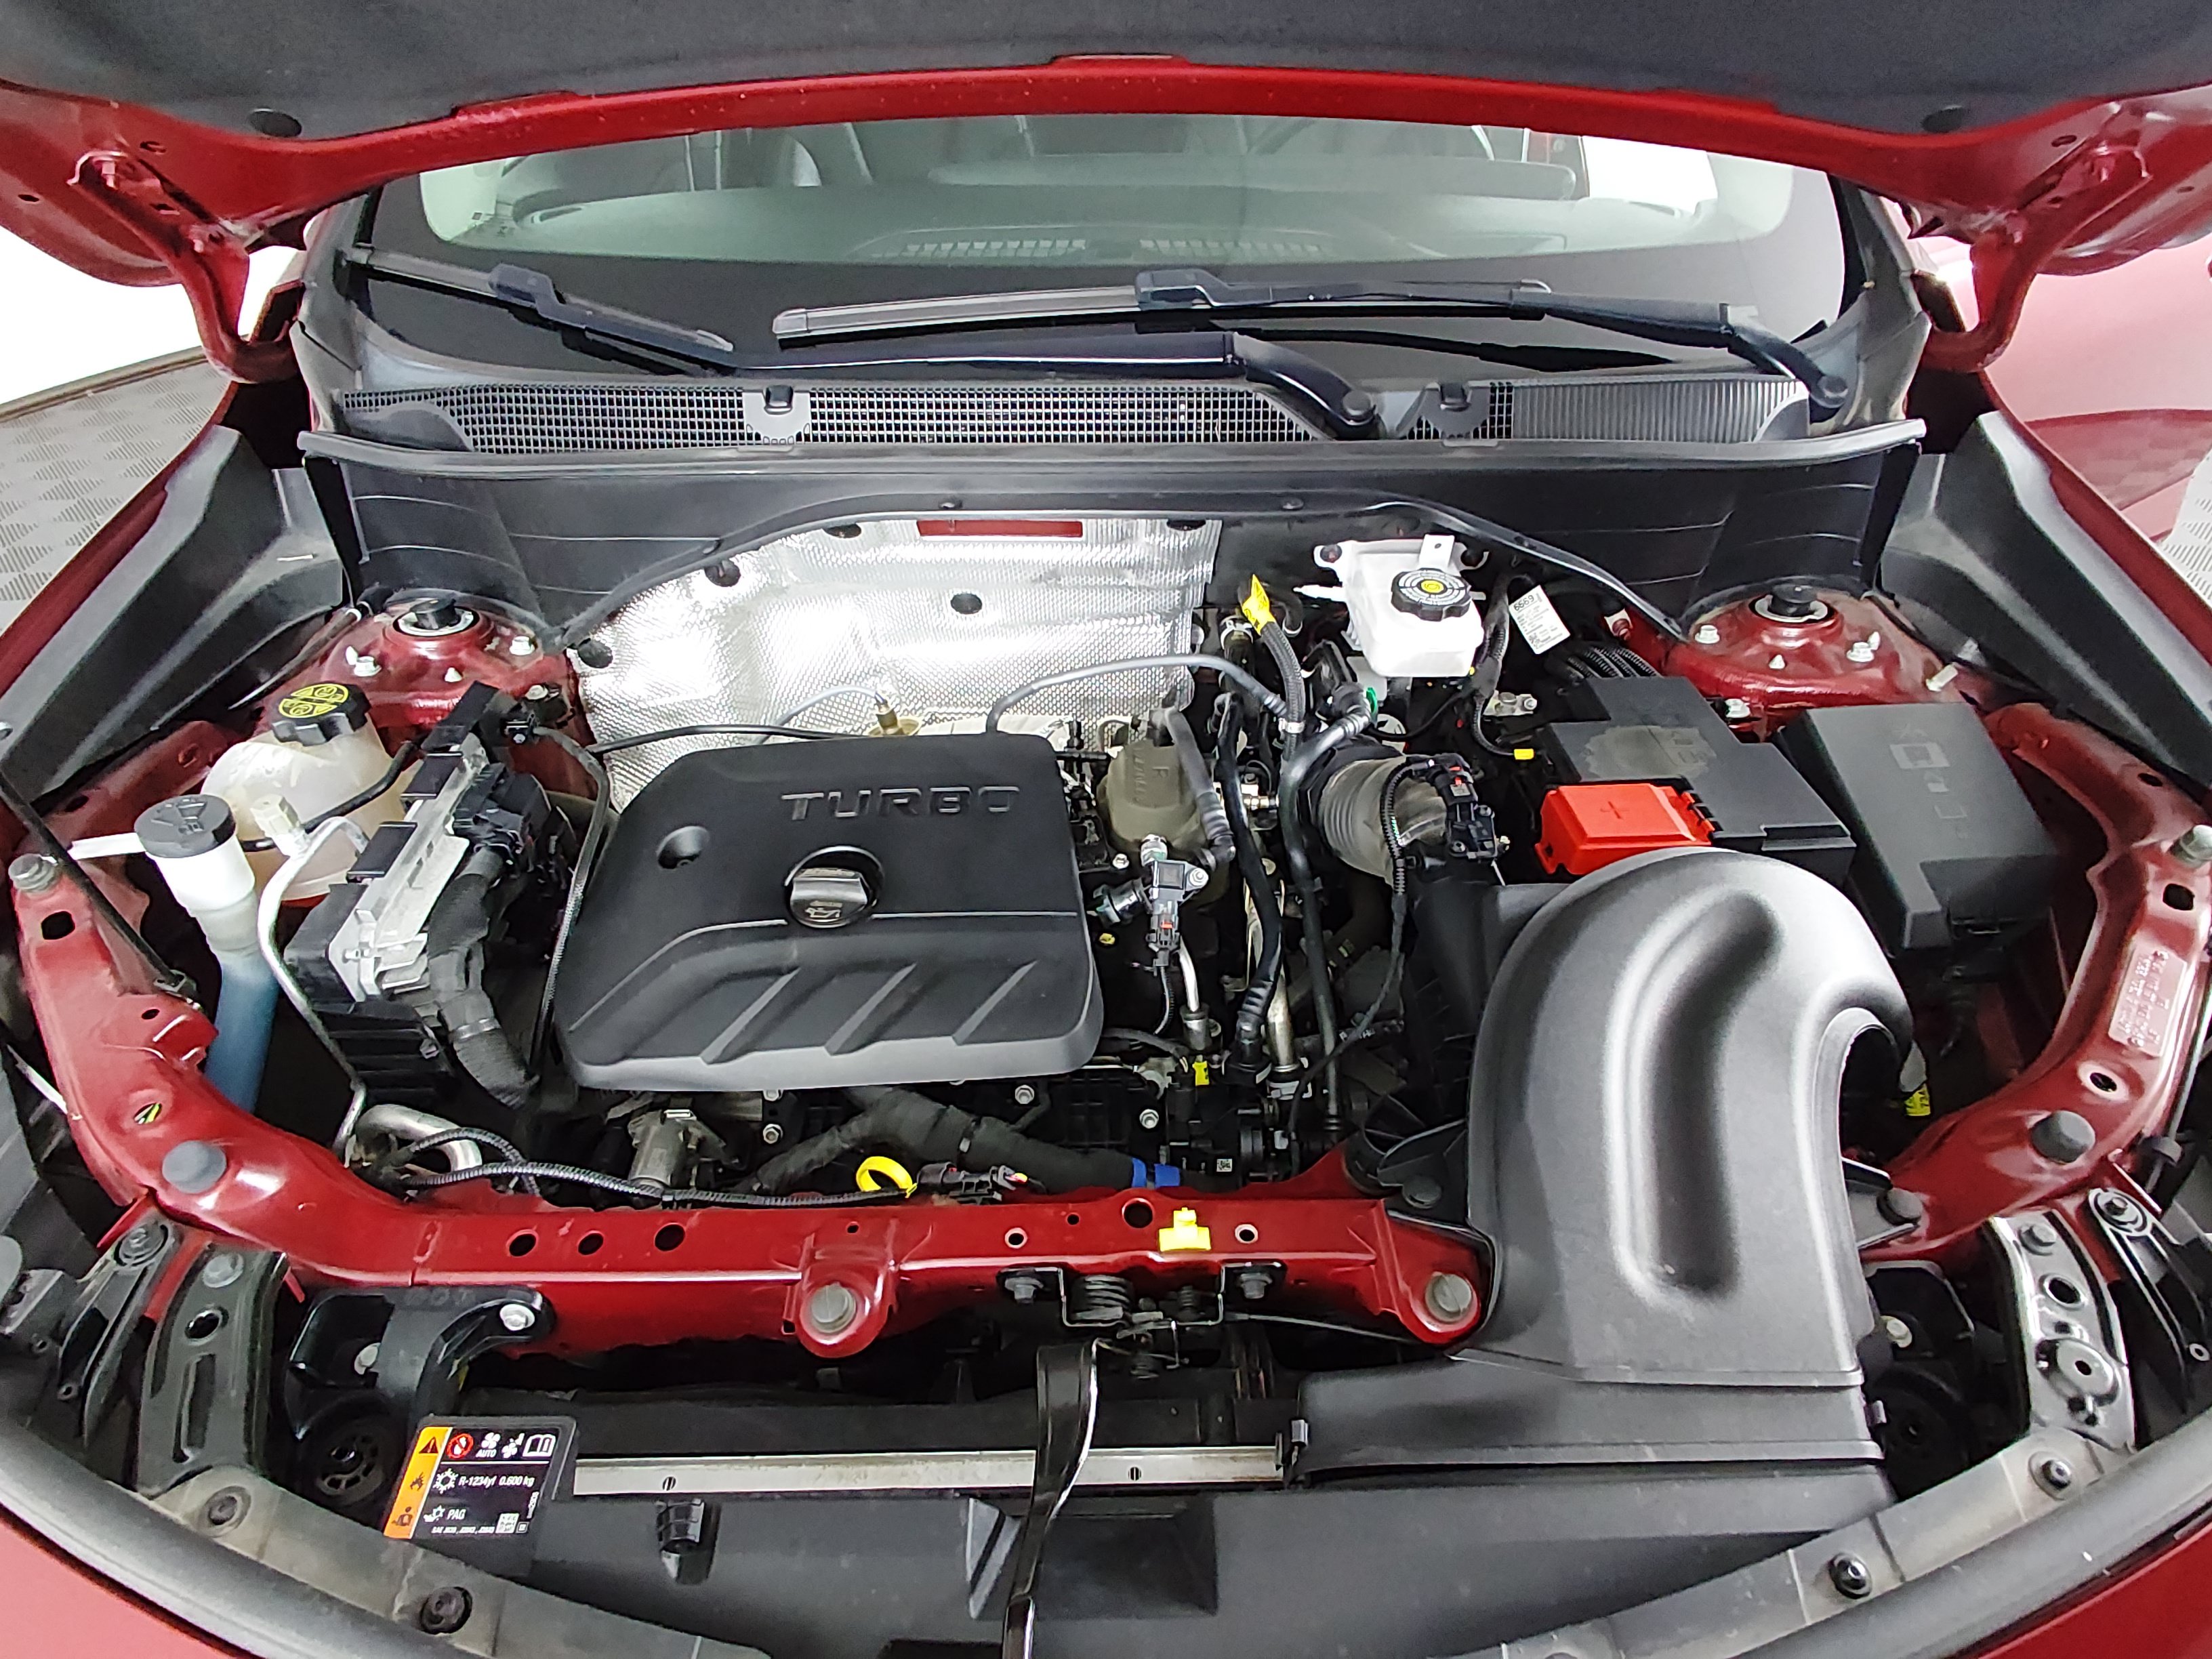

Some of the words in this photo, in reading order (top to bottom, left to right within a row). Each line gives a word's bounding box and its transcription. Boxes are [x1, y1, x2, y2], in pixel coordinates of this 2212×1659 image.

[781, 786, 1020, 820] TURBO
[476, 1449, 497, 1458] AUTO
[499, 1475, 523, 1486] 0.600
[523, 1475, 535, 1488] kg
[447, 1509, 466, 1519] PAG
